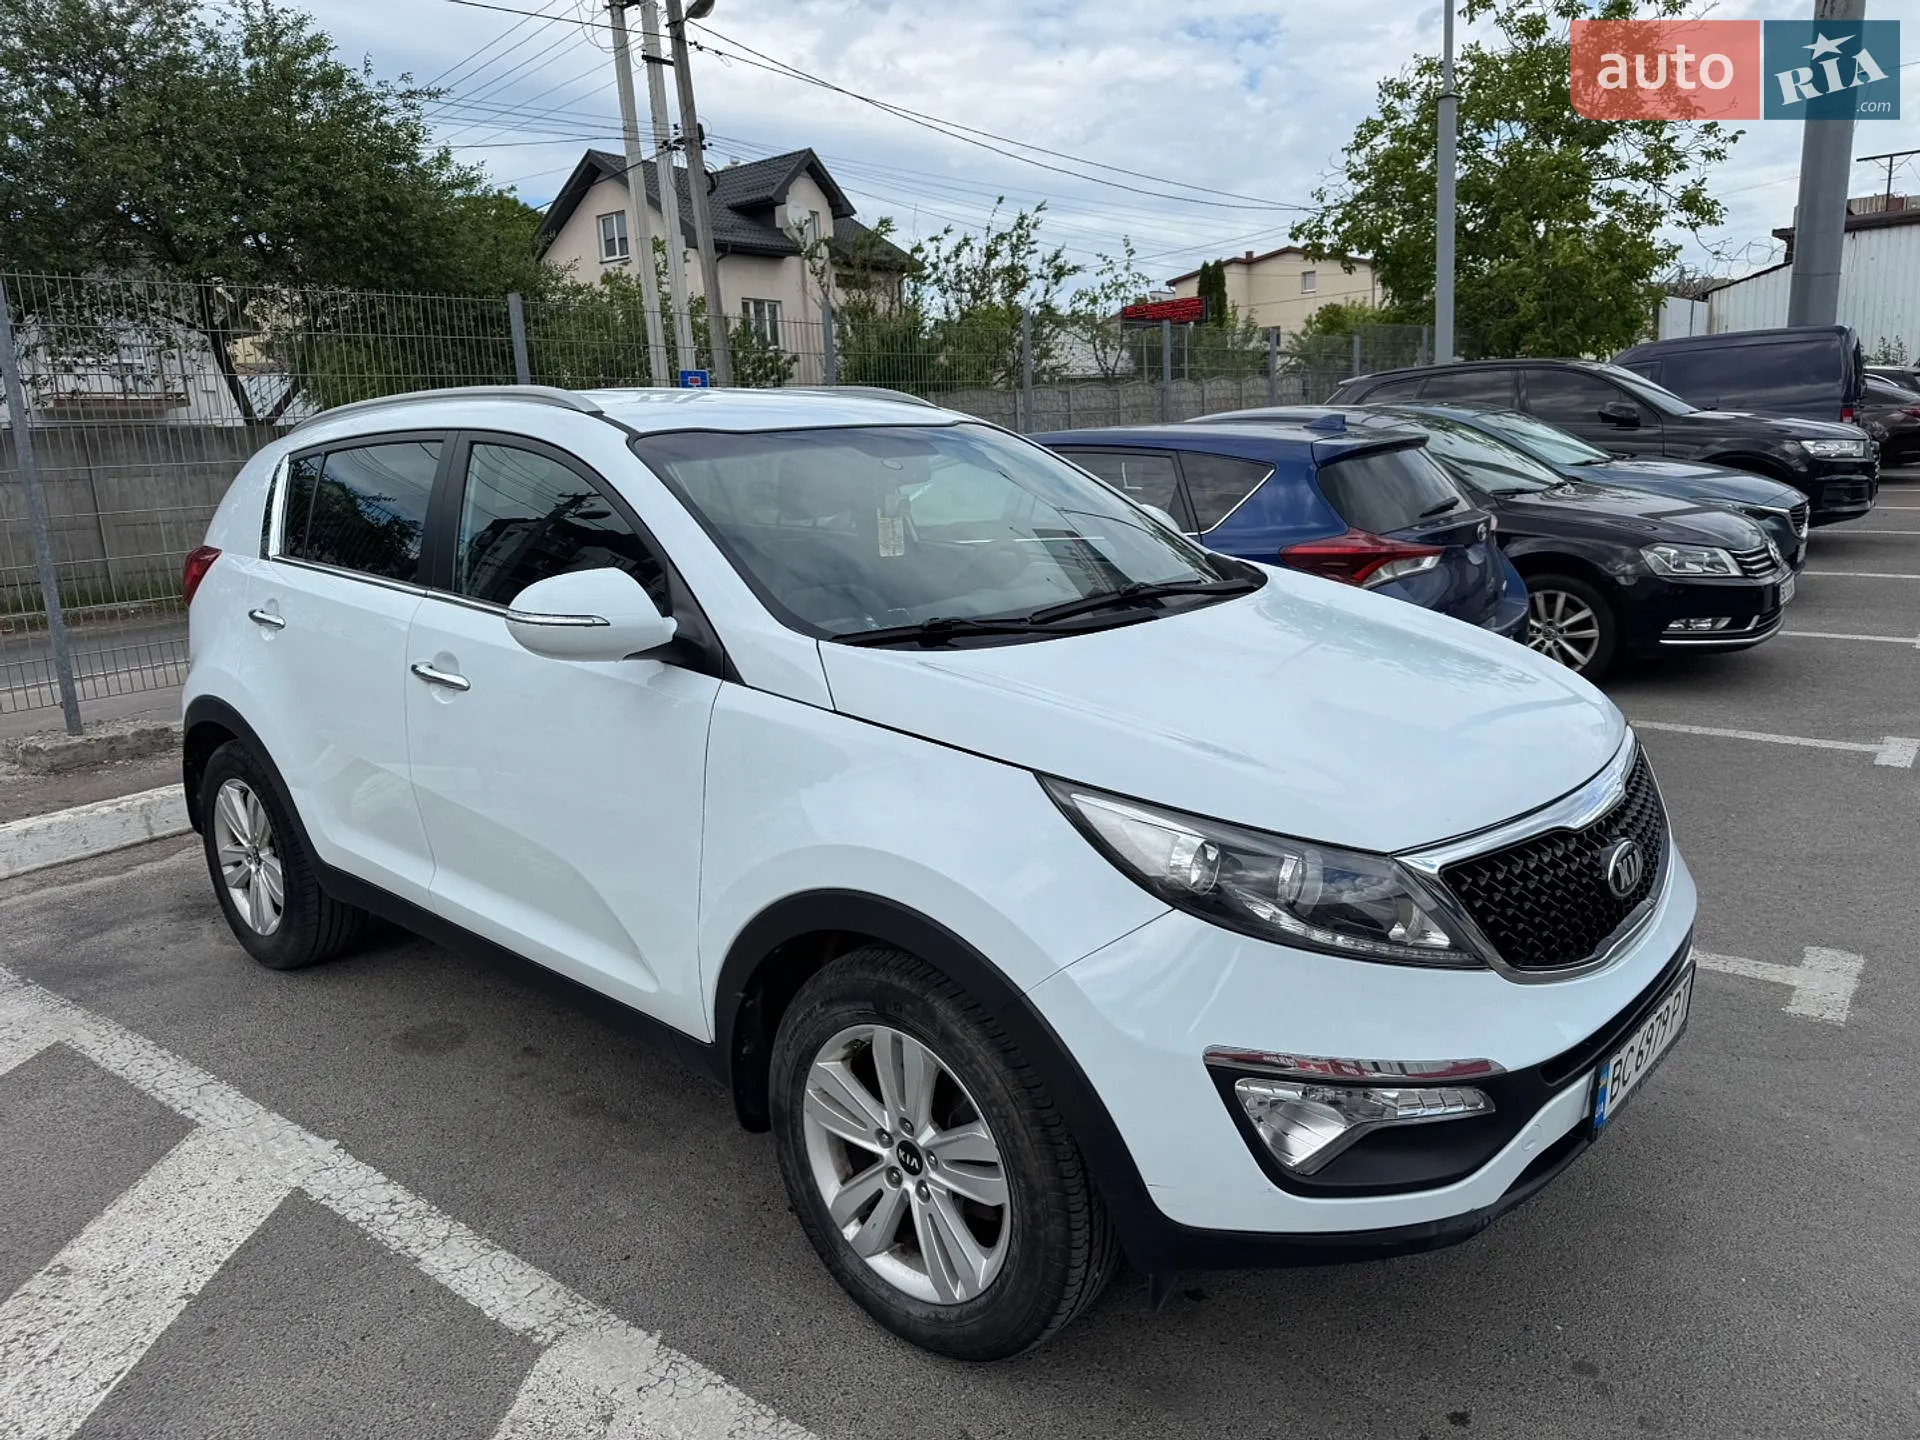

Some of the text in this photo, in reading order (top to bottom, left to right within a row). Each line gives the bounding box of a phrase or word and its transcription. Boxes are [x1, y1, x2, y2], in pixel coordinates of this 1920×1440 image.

[1616, 849, 1643, 890] KIA
[1609, 1045, 1635, 1104] BC
[1635, 1004, 1670, 1072] 6979
[898, 1147, 920, 1169] KIA
